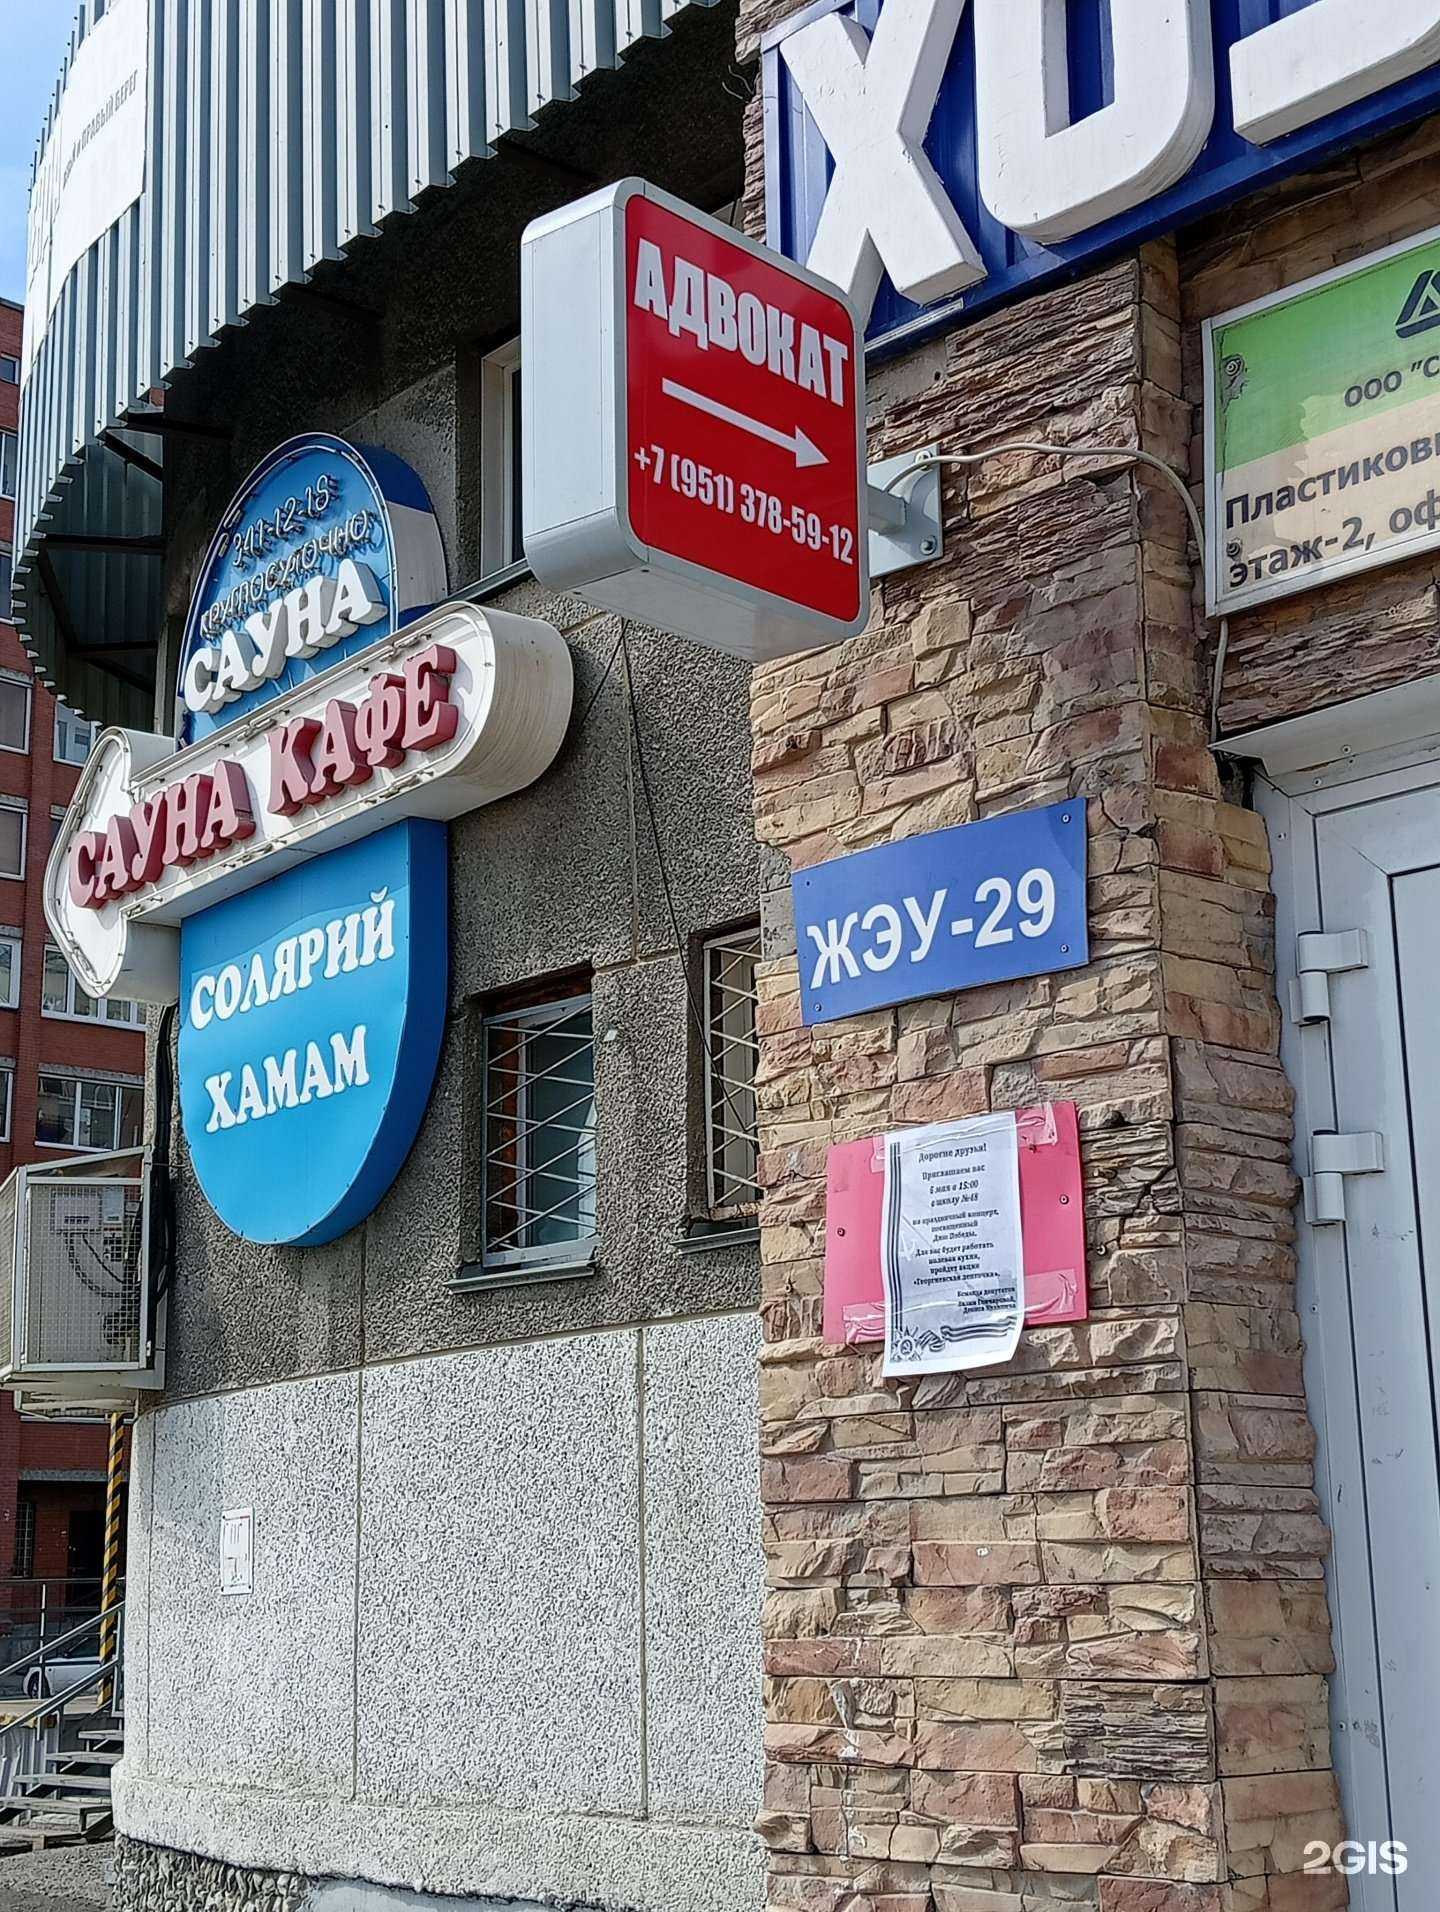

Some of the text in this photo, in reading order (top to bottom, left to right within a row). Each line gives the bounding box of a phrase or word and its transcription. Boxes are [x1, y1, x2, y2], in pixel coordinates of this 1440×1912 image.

[780, 0, 1440, 304] ХО
[633, 238, 847, 408] АДВОКАТ
[1344, 371, 1402, 408] ООО
[633, 444, 854, 566] +7 (951) 378-59-12
[1229, 516, 1376, 589] этаж-2,
[184, 558, 388, 716] САУНА
[69, 644, 458, 909] САУНА КАФЕ
[189, 886, 396, 1031] СОЛЯРИЙ
[807, 868, 1056, 990] ЖЭУ-29
[203, 1024, 370, 1133] ХАМАМ
[918, 1143, 987, 1163] Дорогие друзья!
[922, 1164, 985, 1181] Приглашаем вас
[959, 1180, 979, 1190] 15:00
[915, 1249, 928, 1257] Для
[942, 1246, 961, 1254] будет
[962, 1242, 994, 1252] работать
[922, 1212, 966, 1225] праздничный
